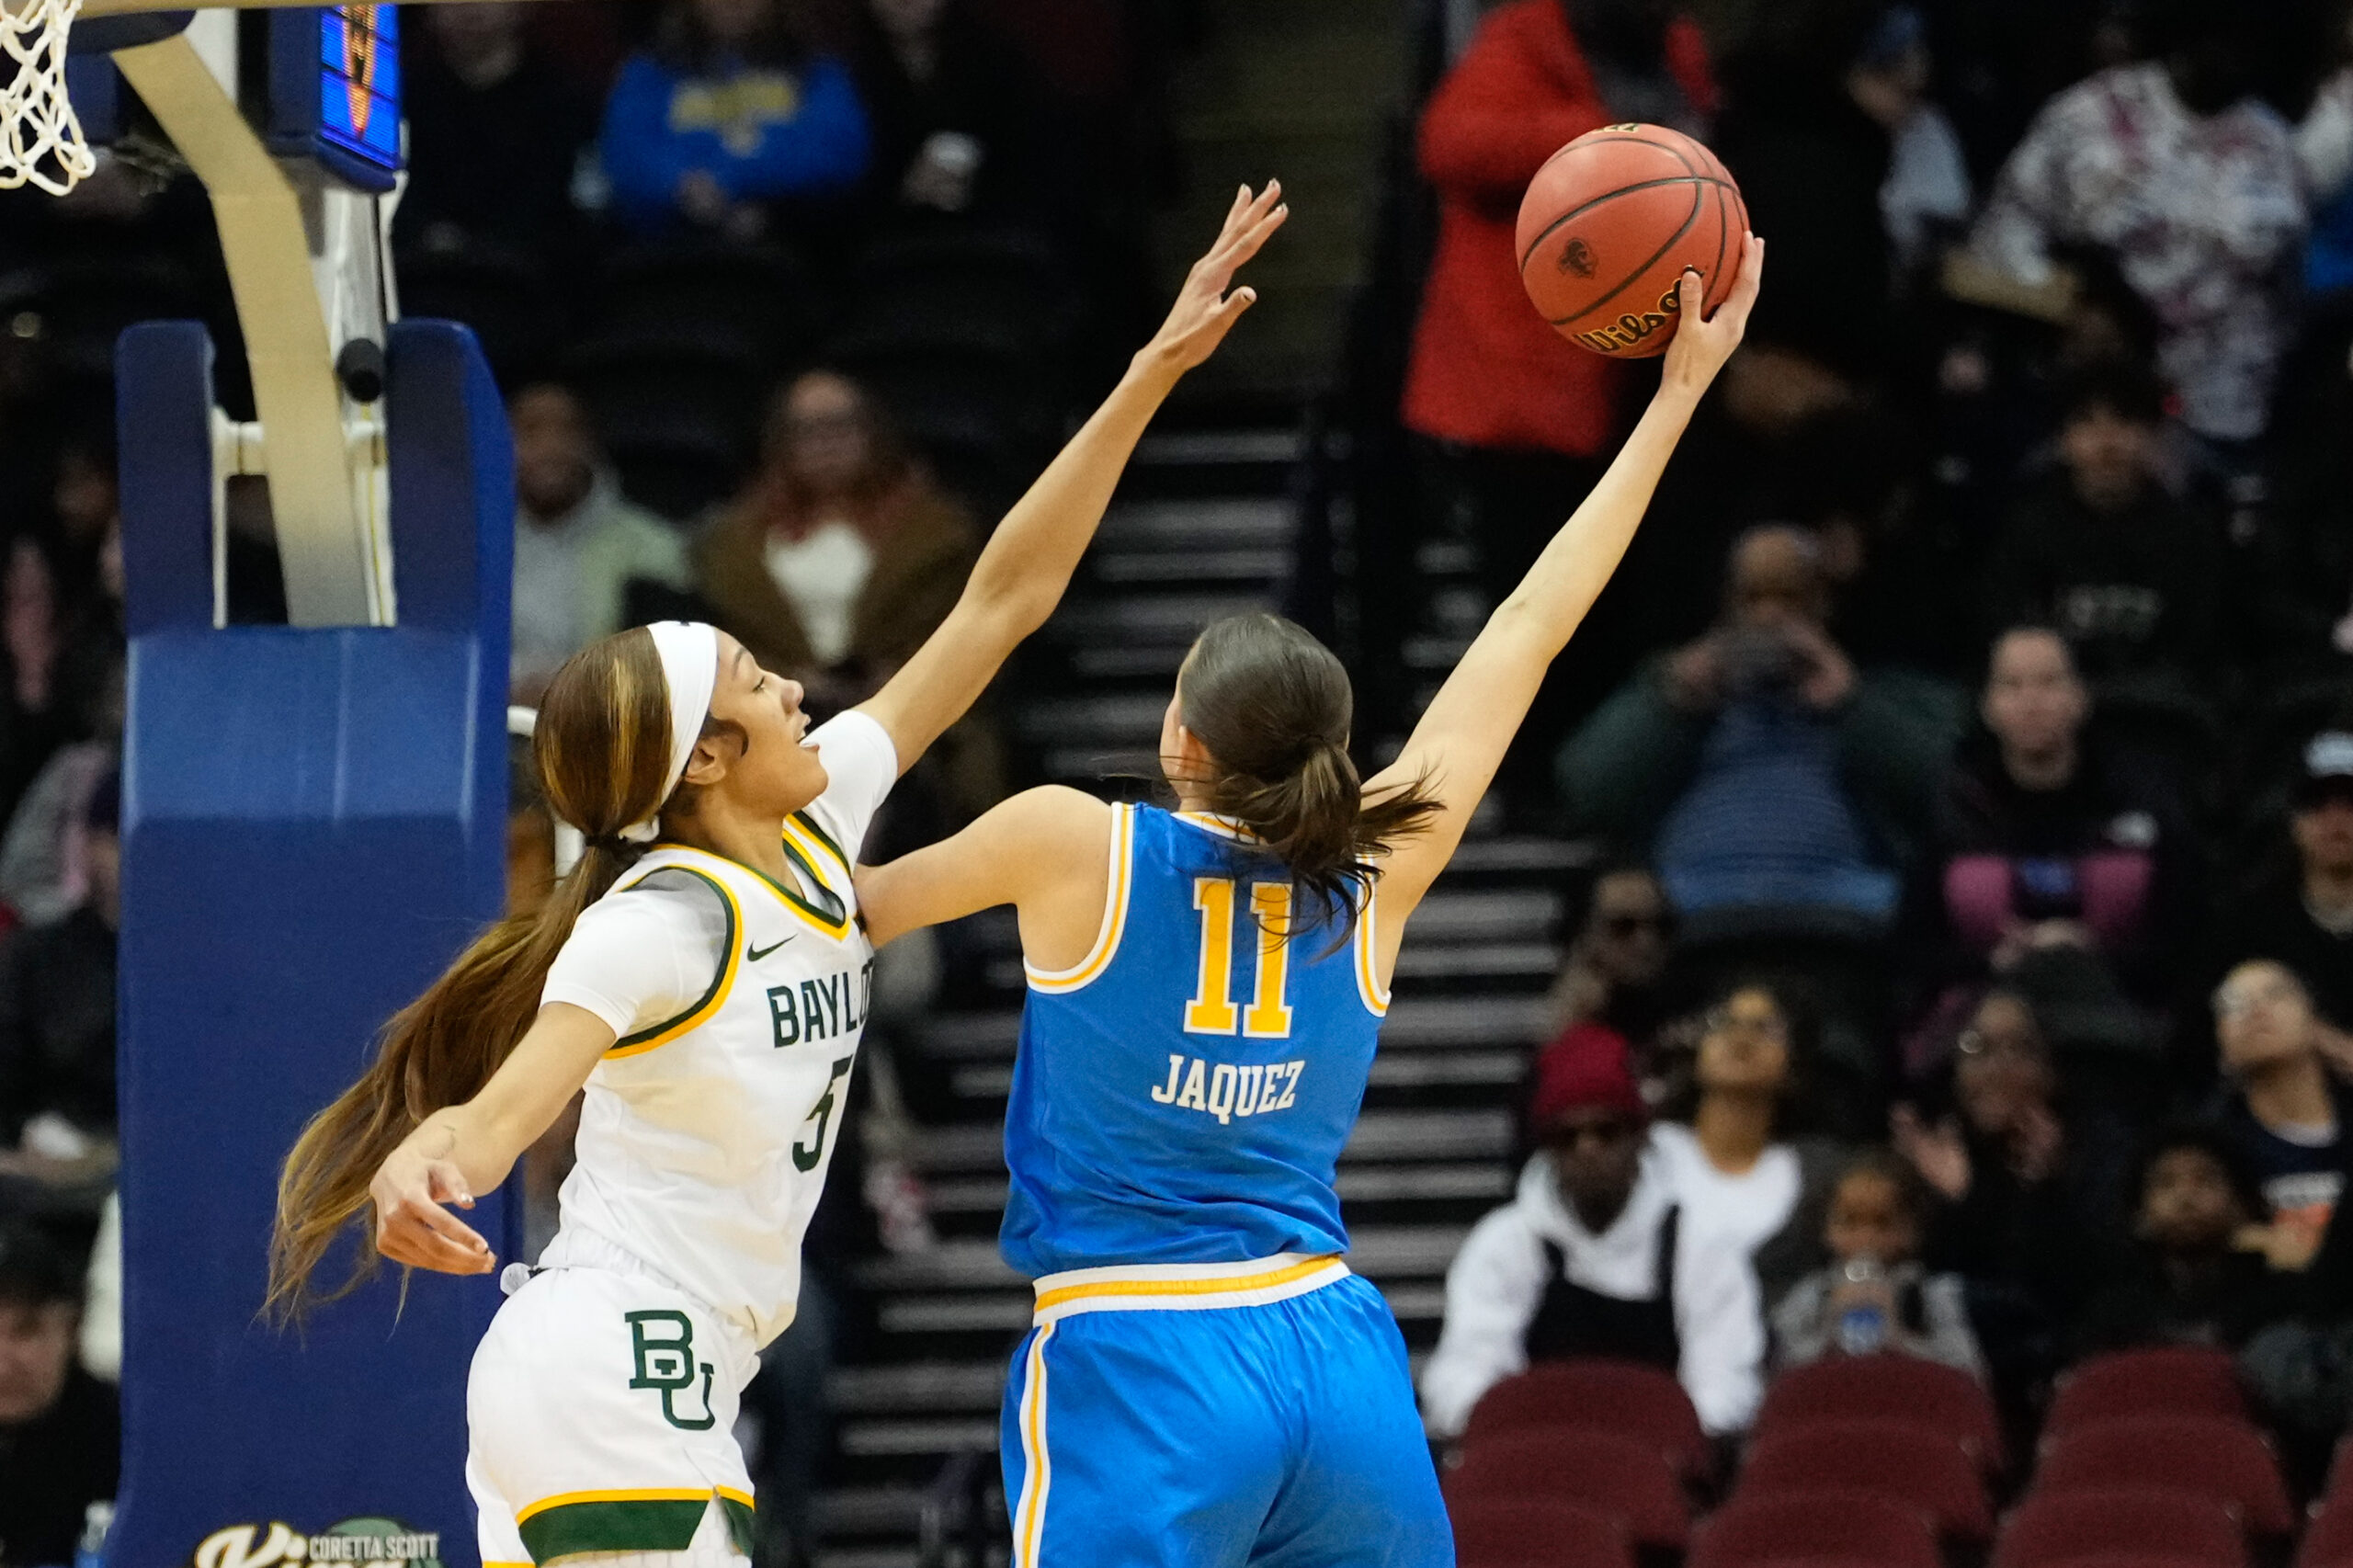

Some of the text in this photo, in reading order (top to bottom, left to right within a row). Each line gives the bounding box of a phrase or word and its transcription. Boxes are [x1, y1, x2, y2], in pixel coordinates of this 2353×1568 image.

[767, 956, 874, 1048] BAYLO
[1183, 877, 1292, 1038] 11
[792, 1054, 853, 1173] 5
[1151, 1054, 1305, 1125] JAQUEZ
[624, 1310, 715, 1430] BU
[309, 1533, 438, 1561] CORETTA SCOTT
